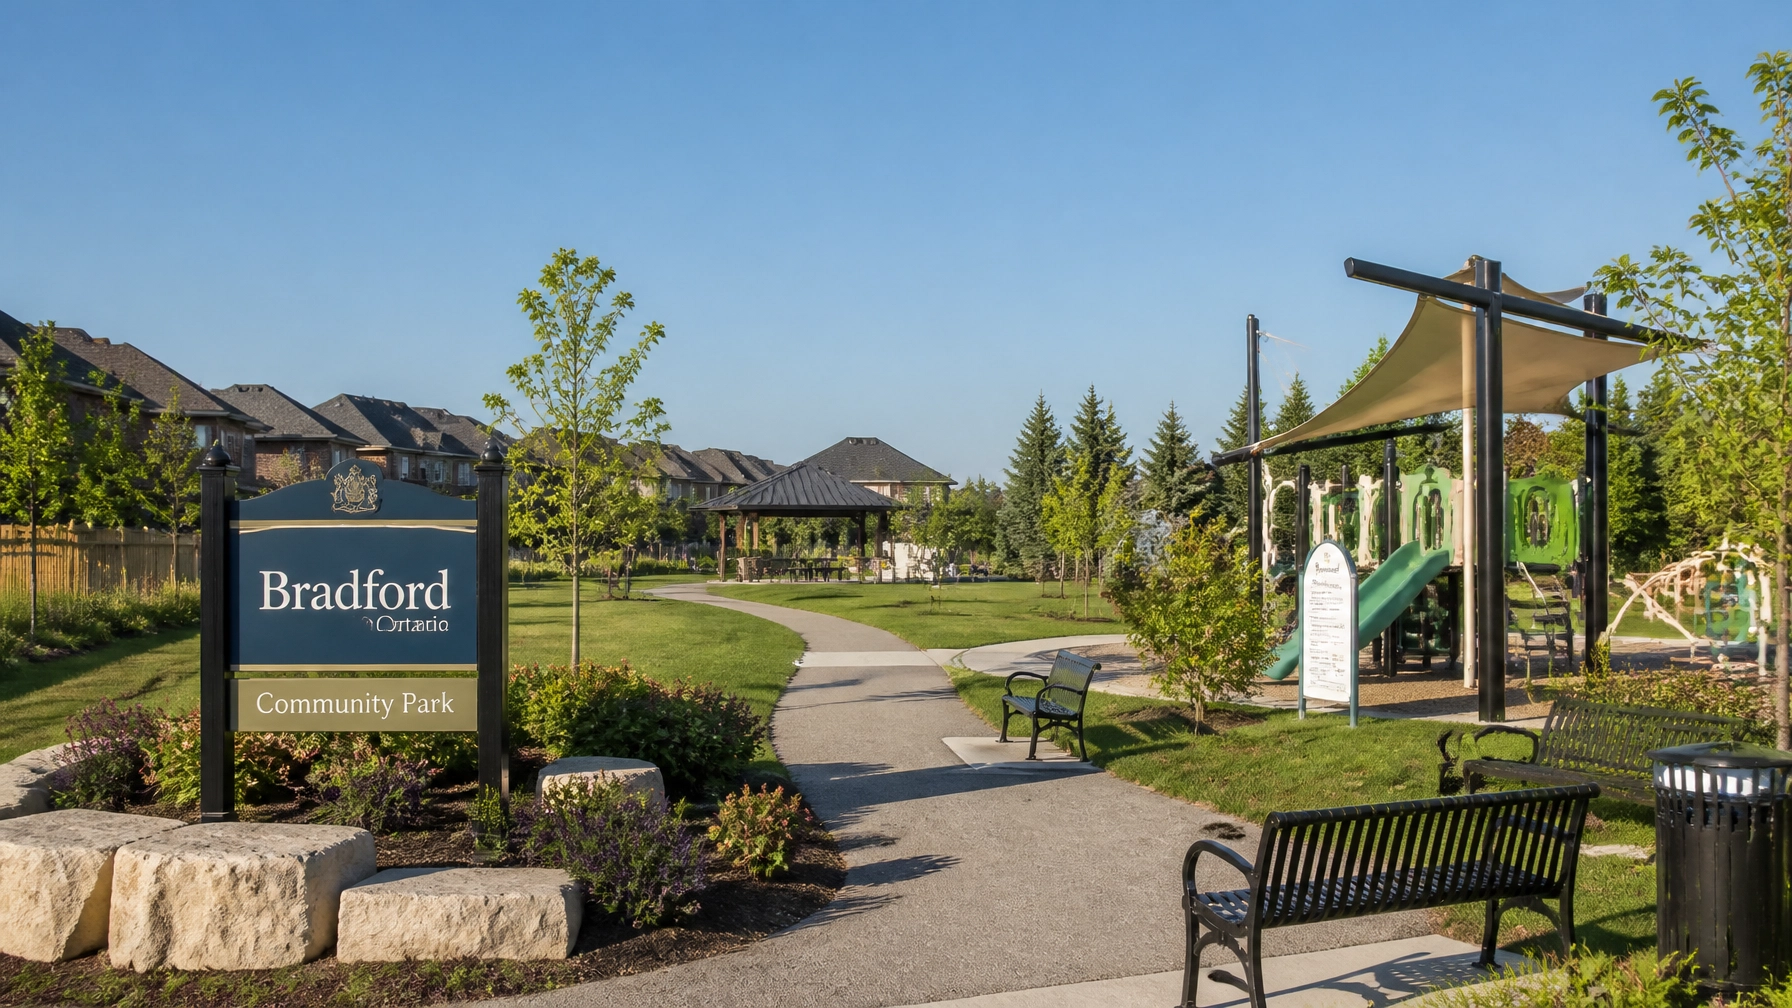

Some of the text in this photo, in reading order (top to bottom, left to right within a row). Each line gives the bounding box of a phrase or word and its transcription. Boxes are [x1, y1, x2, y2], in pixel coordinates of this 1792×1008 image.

[259, 568, 452, 611] Bradford
[256, 691, 455, 720] Community Park
